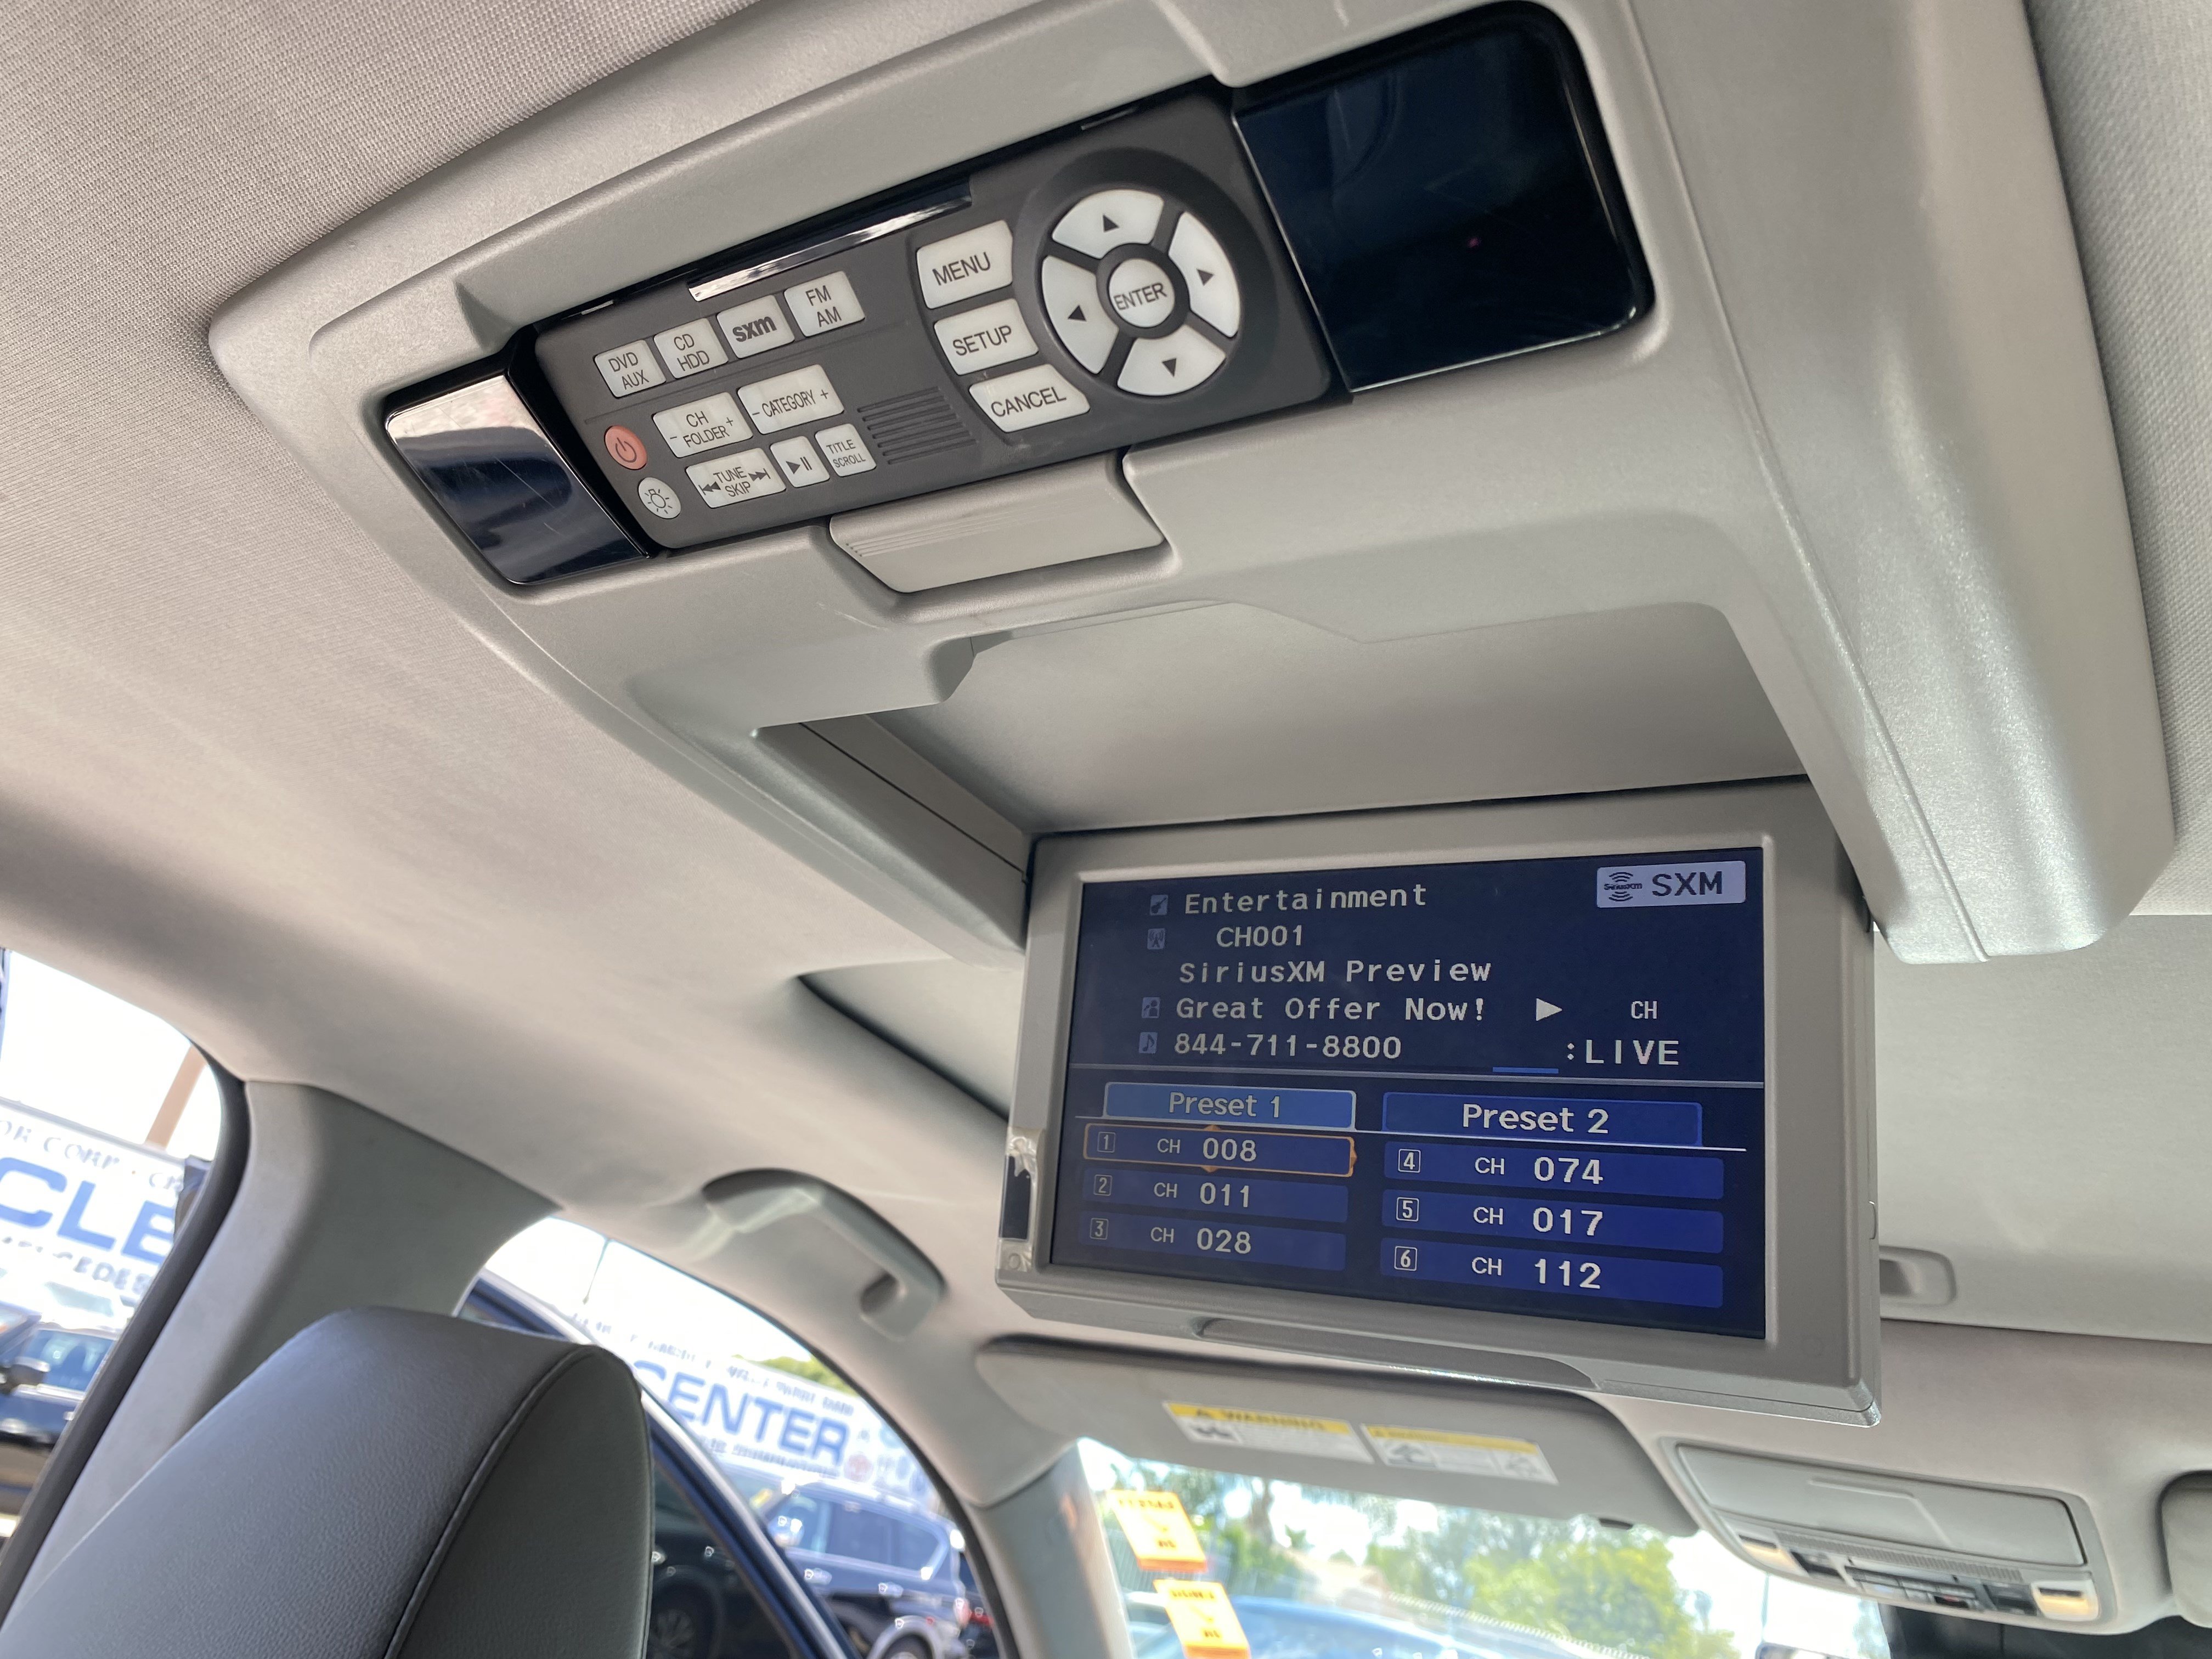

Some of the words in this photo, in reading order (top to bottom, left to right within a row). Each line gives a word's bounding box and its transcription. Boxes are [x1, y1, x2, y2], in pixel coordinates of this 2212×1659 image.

[933, 252, 991, 286] MENU
[805, 285, 831, 306] FM
[1114, 282, 1167, 310] ENTER
[732, 316, 777, 342] sxm
[817, 307, 842, 327] AM
[674, 334, 695, 350] CD
[953, 325, 1012, 356] SETUP
[608, 352, 639, 372] DVD
[678, 351, 710, 371] HDD
[622, 371, 649, 390] AUX
[761, 390, 816, 418] CATEGORY
[991, 387, 1066, 416] CANCEL
[686, 411, 709, 427] CH
[683, 425, 729, 448] FOLDER
[826, 439, 856, 454] TITLE
[833, 454, 866, 468] SCROLL
[714, 466, 747, 484] TUNE
[725, 482, 751, 496] SKIP
[1652, 871, 1722, 896] SXM
[1185, 884, 1426, 914] Entertainment
[1217, 925, 1303, 947] CH001
[1180, 961, 1325, 983] SiriusXM
[1346, 960, 1491, 982] Preview
[1176, 997, 1263, 1019] Great
[1285, 997, 1380, 1019] Offer
[1405, 998, 1483, 1020] Now!
[1631, 1001, 1657, 1019] CH
[1175, 1033, 1401, 1059] 844-711-8800
[1169, 1092, 1257, 1118] Preset
[1270, 1096, 1280, 1118] 1
[1463, 1104, 1574, 1133] Preset
[1588, 1109, 1609, 1133] 2
[1103, 1135, 1110, 1150] 1
[1157, 1138, 1181, 1154] CH
[1203, 1137, 1257, 1162] 008
[1403, 1153, 1415, 1170] 4
[1475, 1157, 1504, 1175] CH
[1534, 1156, 1603, 1184] 074
[1098, 1177, 1108, 1193] 2
[1154, 1182, 1177, 1198] CH
[1199, 1182, 1250, 1207] 011
[1402, 1200, 1413, 1218] 5
[1473, 1207, 1504, 1225] CH
[1533, 1207, 1603, 1236] 017
[1094, 1221, 1104, 1238] 3
[1150, 1227, 1175, 1243] CH
[1197, 1228, 1251, 1254] 028
[1400, 1250, 1411, 1267] 6
[1472, 1257, 1502, 1276] CH
[1534, 1259, 1601, 1289] 112
